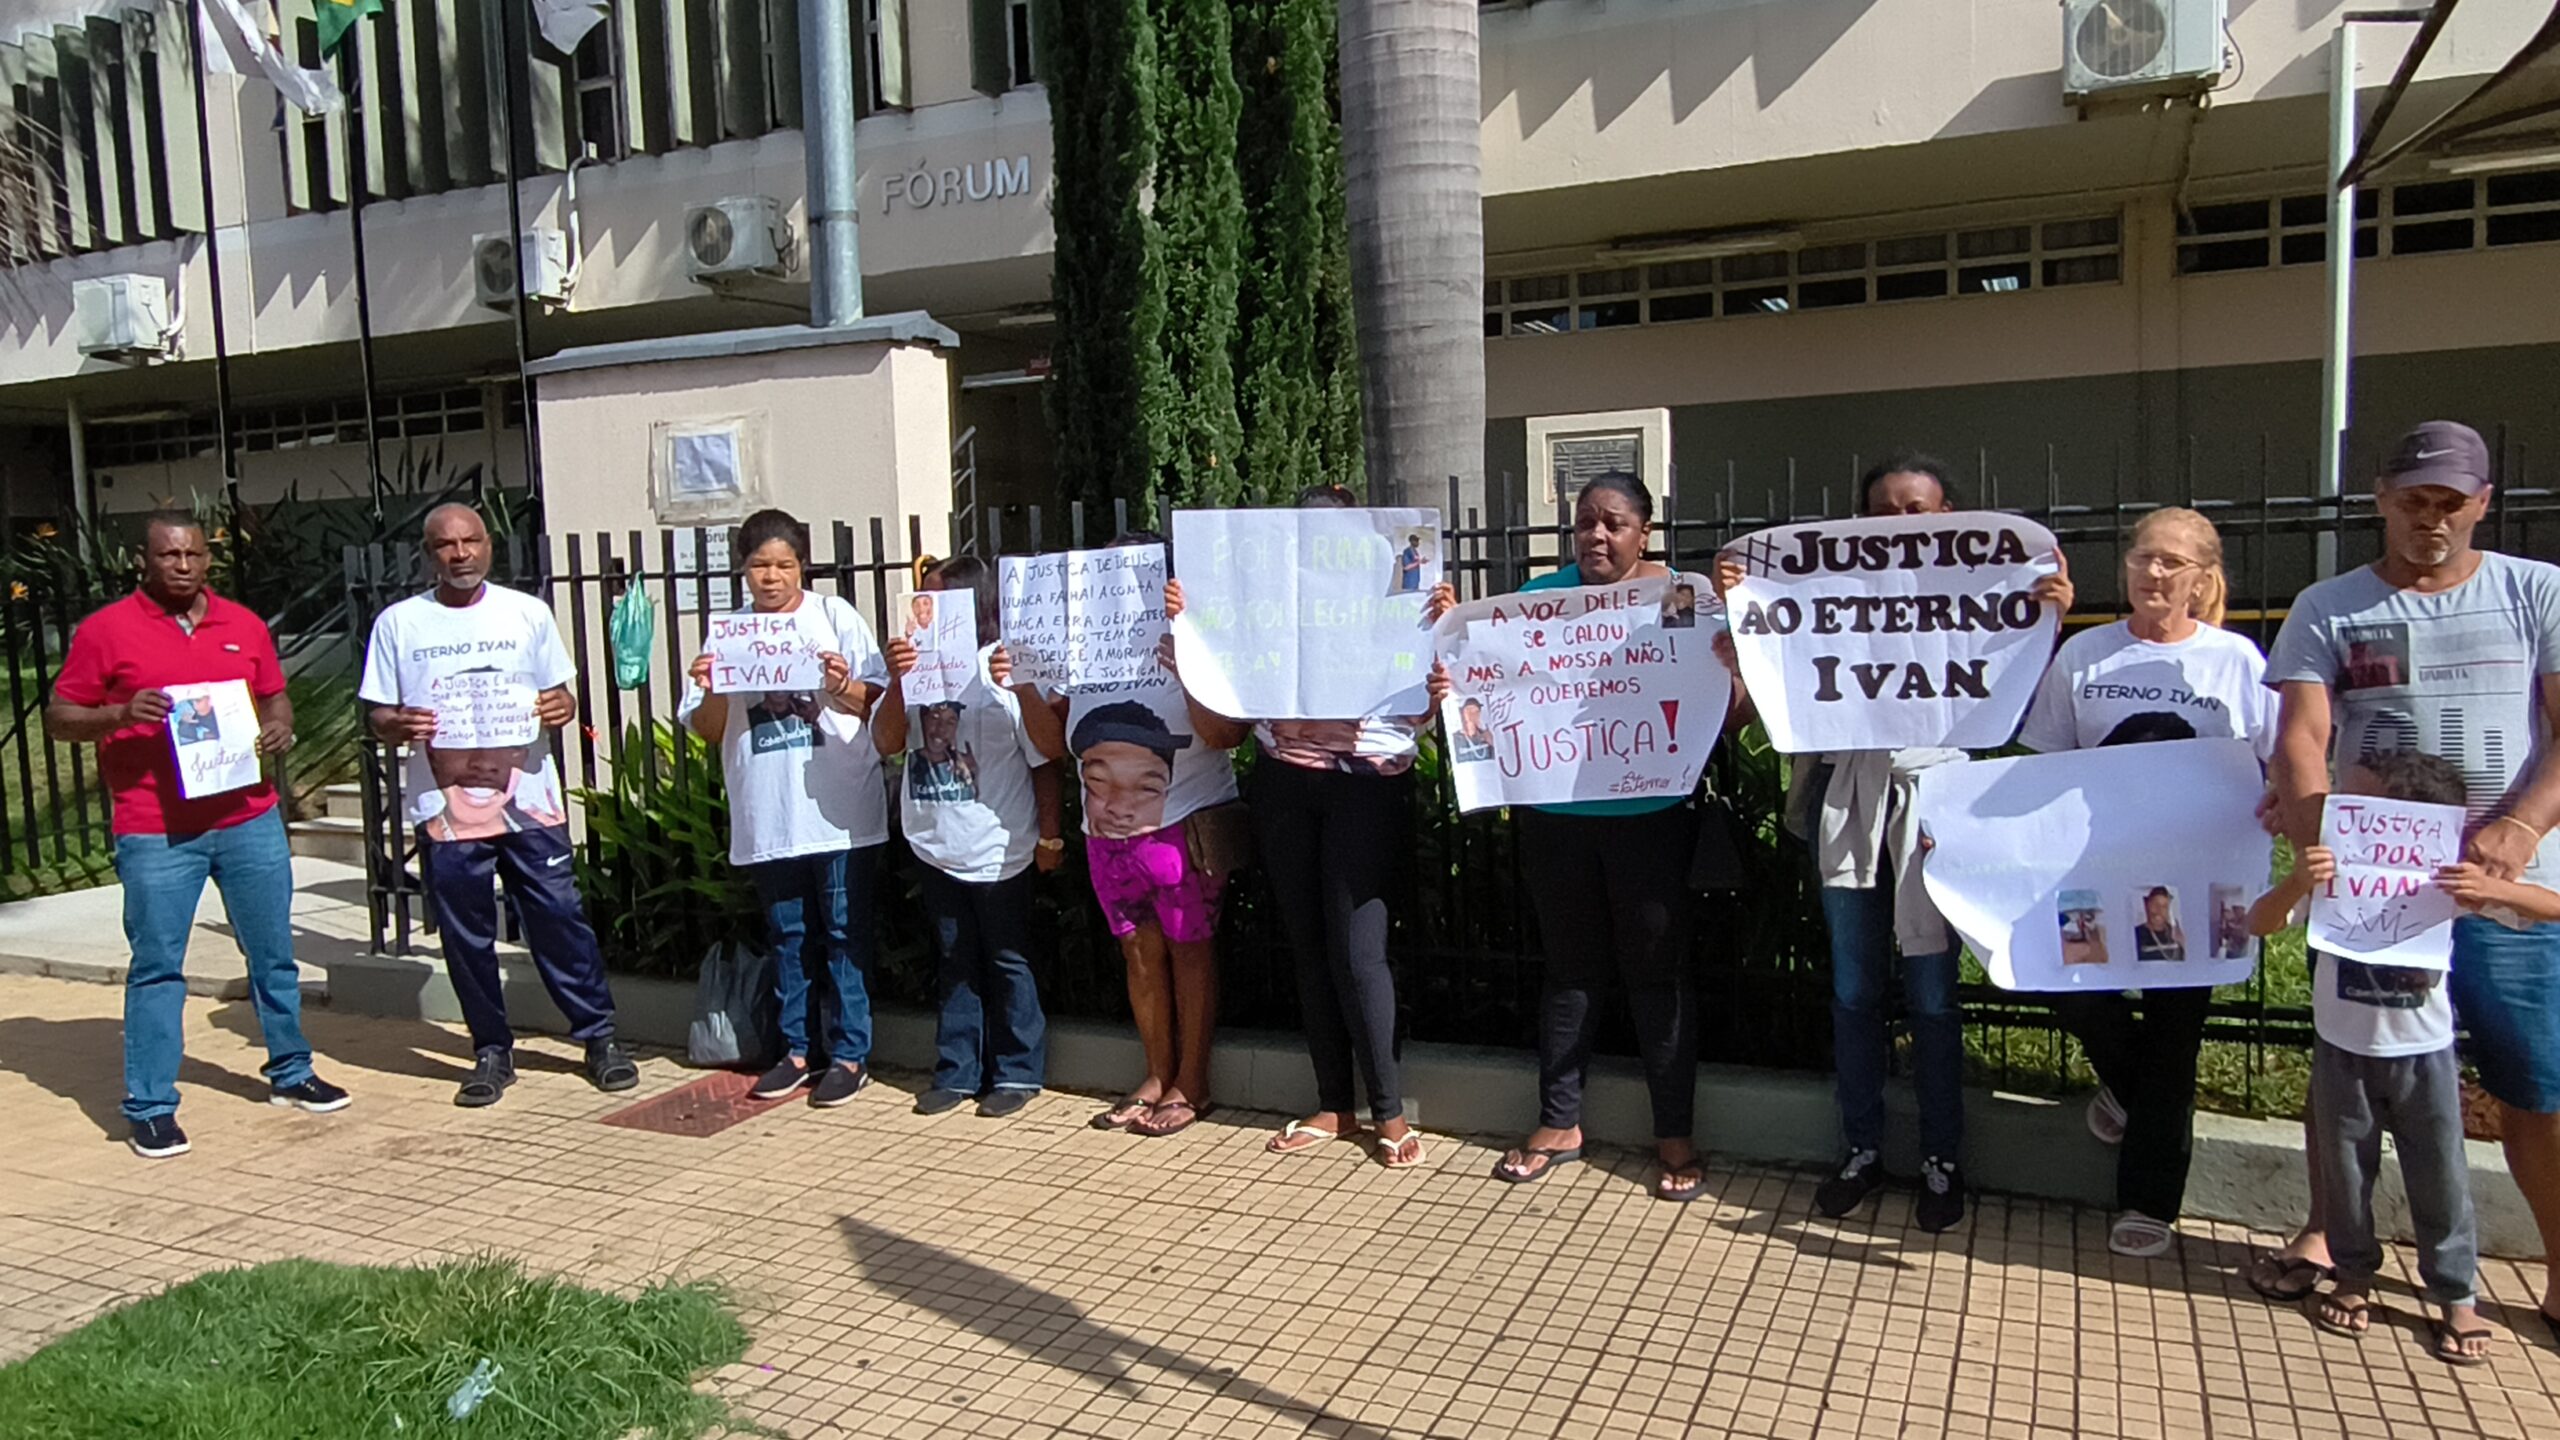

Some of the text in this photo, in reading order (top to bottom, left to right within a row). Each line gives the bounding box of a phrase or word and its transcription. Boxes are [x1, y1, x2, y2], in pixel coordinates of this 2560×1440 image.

[882, 157, 1031, 215] FÓRUM
[1002, 592, 1043, 610] NUNCA
[1491, 588, 1641, 627] A VOZ DELE
[1737, 590, 2041, 636] AO ETERNO
[713, 617, 798, 640] JUSTIÇA
[1003, 616, 1045, 631] NUNCA
[412, 639, 517, 662] ETERNO IVAN
[748, 640, 794, 659] POR
[718, 663, 792, 687] IVAN
[1466, 663, 1504, 683] MAS
[1518, 660, 1534, 677] A
[1549, 650, 1613, 672] NOSSA
[1812, 655, 1992, 702] IVAN
[1123, 677, 1167, 691] IVAN
[1530, 677, 1641, 705] QUEREMOS
[2083, 684, 2221, 712] ETERNO IVAN
[2337, 805, 2443, 841] JUSTIÇA
[2362, 842, 2425, 868] POR
[2324, 873, 2420, 900] IVAN
